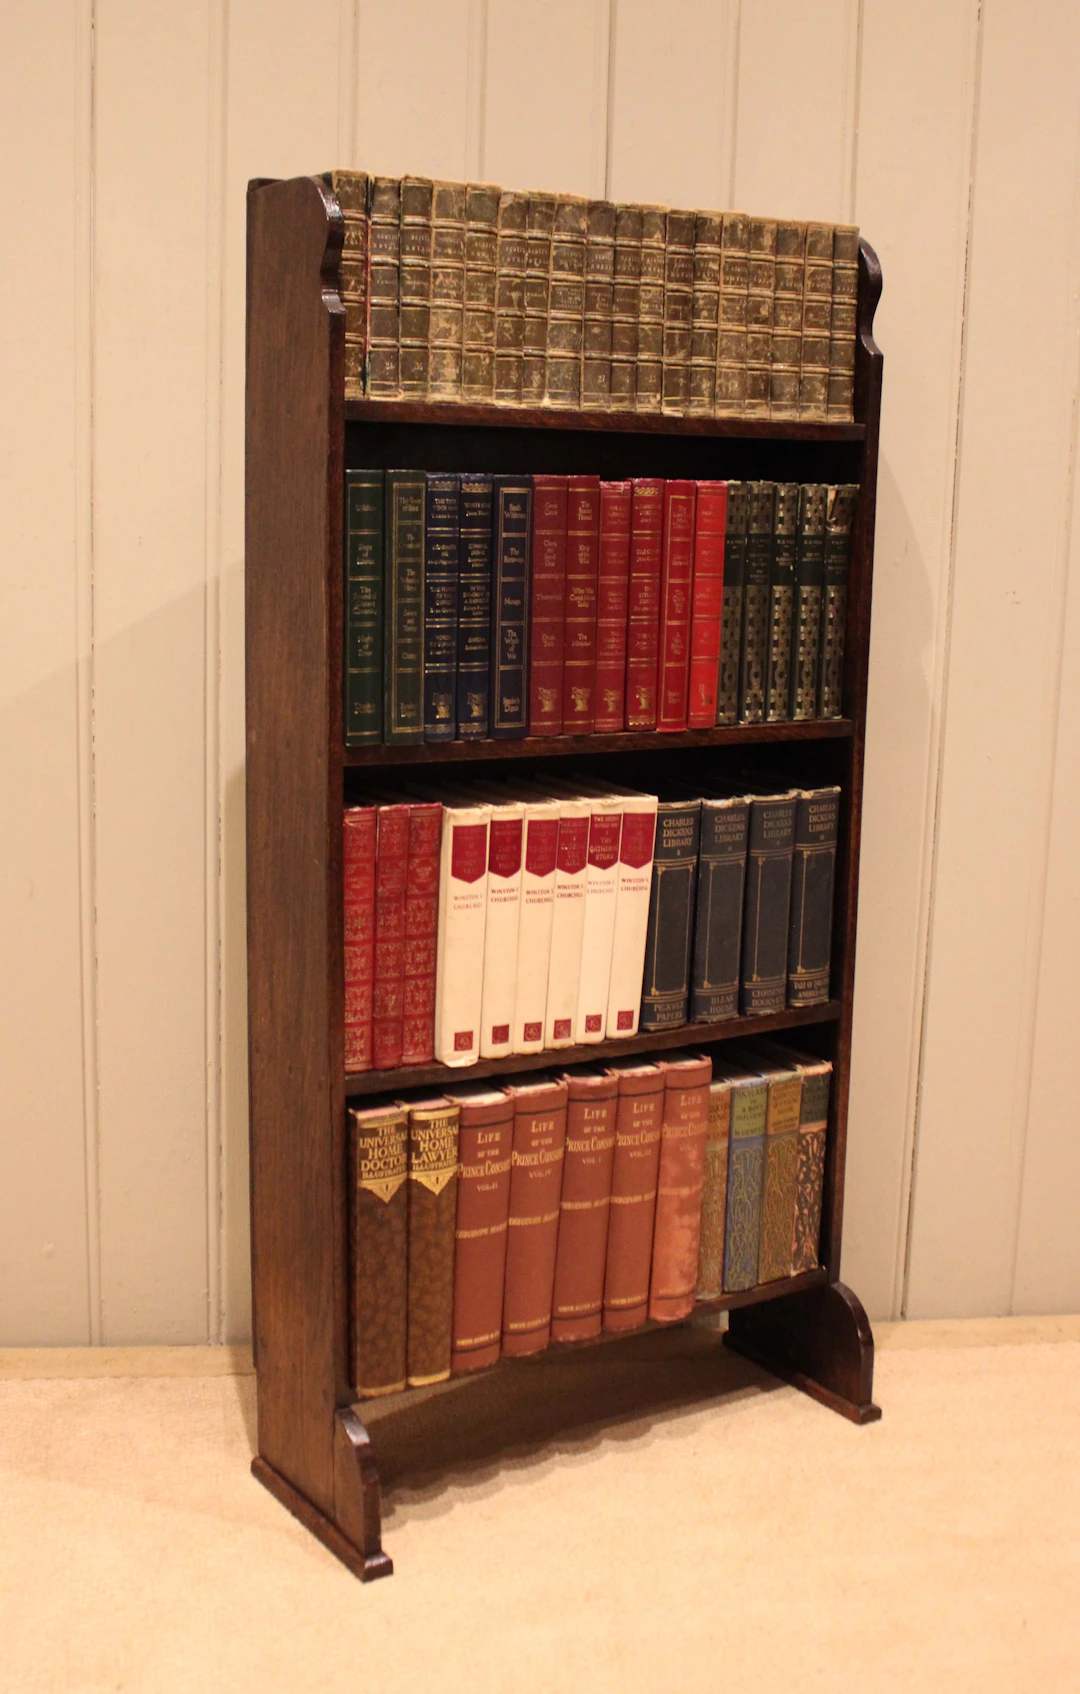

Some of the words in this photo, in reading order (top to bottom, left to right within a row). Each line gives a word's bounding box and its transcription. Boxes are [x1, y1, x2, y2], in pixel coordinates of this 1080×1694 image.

[763, 808, 793, 819] CHARLES
[808, 803, 836, 814] CHARLES
[663, 817, 694, 828] CHARLES
[714, 813, 745, 823] CHARLES
[808, 812, 836, 823] DICKENS
[714, 822, 745, 833] DICKENS
[763, 818, 792, 830] DICKENS
[808, 822, 835, 833] LIBRARY
[663, 827, 694, 838] DICKENS
[714, 833, 744, 843] LIBRARY
[763, 828, 792, 839] LIBRARY
[663, 838, 693, 848] LIBRARY
[710, 1004, 733, 1014] HOUSE
[584, 1108, 607, 1120] LIFE
[633, 1103, 655, 1114] LIFE
[429, 1118, 448, 1129] THE
[531, 1121, 554, 1133] LIFE
[377, 1125, 396, 1137] THE
[359, 1130, 407, 1148] UNIVERSA
[477, 1132, 501, 1144] LIFE
[419, 1136, 454, 1153] HOME
[368, 1143, 403, 1160] HOME
[411, 1146, 458, 1164] LAWYER
[360, 1152, 407, 1172] DOCTOR
[362, 1164, 406, 1179] ILLUSTRATE
